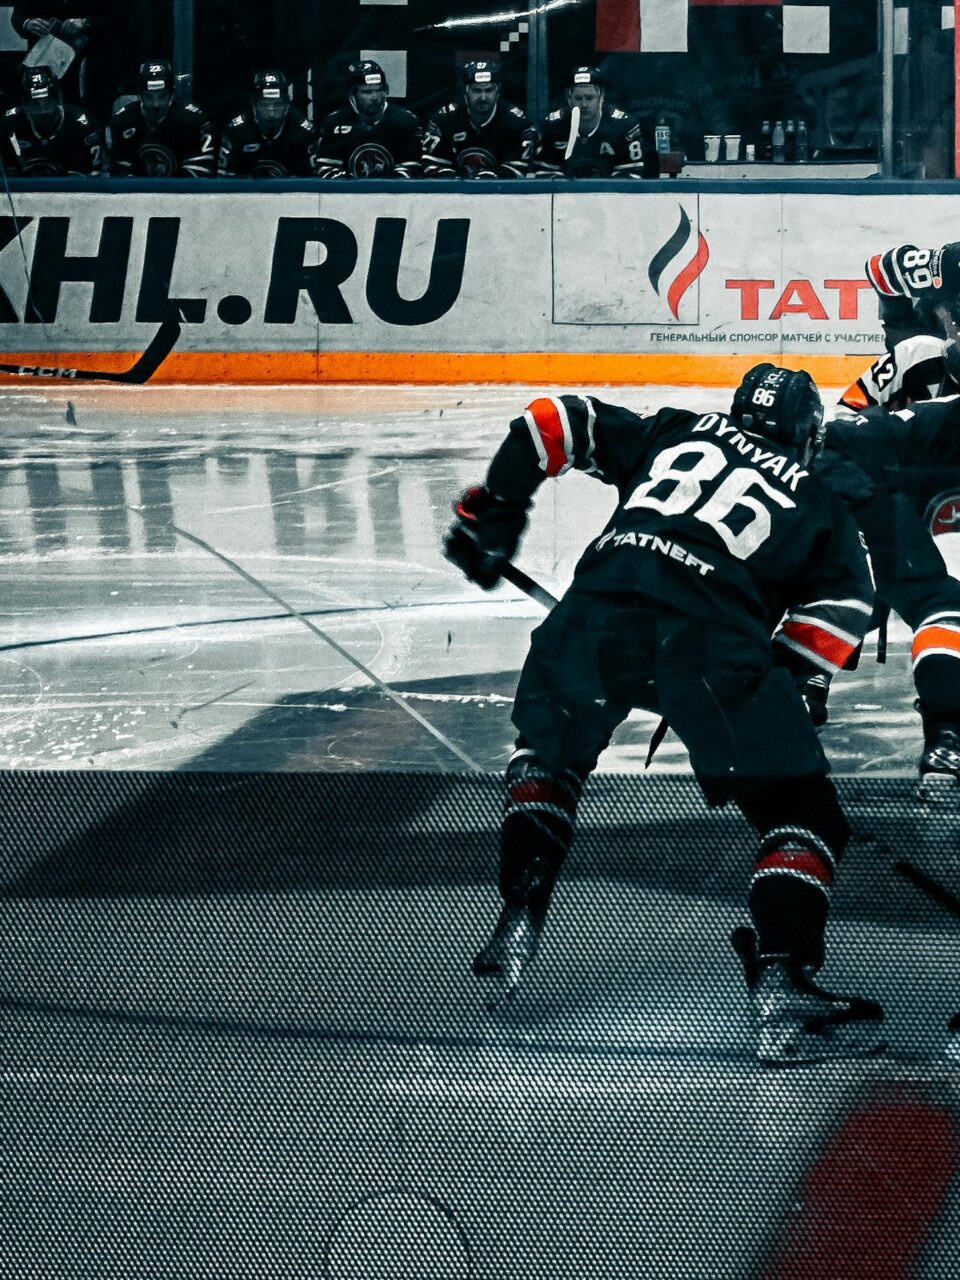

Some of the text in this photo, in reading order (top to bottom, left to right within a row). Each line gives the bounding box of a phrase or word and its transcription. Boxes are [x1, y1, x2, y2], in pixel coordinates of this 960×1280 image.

[903, 250, 932, 289] 89
[650, 332, 727, 343] ГЕНЕРАЛЬНЫЙ
[729, 333, 779, 343] СПОНСОР
[781, 331, 822, 343] МАТЧЕЙ
[825, 333, 831, 343] С
[751, 387, 777, 407] 86
[692, 412, 809, 492] DYNYAK
[623, 440, 797, 561] 86
[613, 531, 715, 576] TATNEFT
